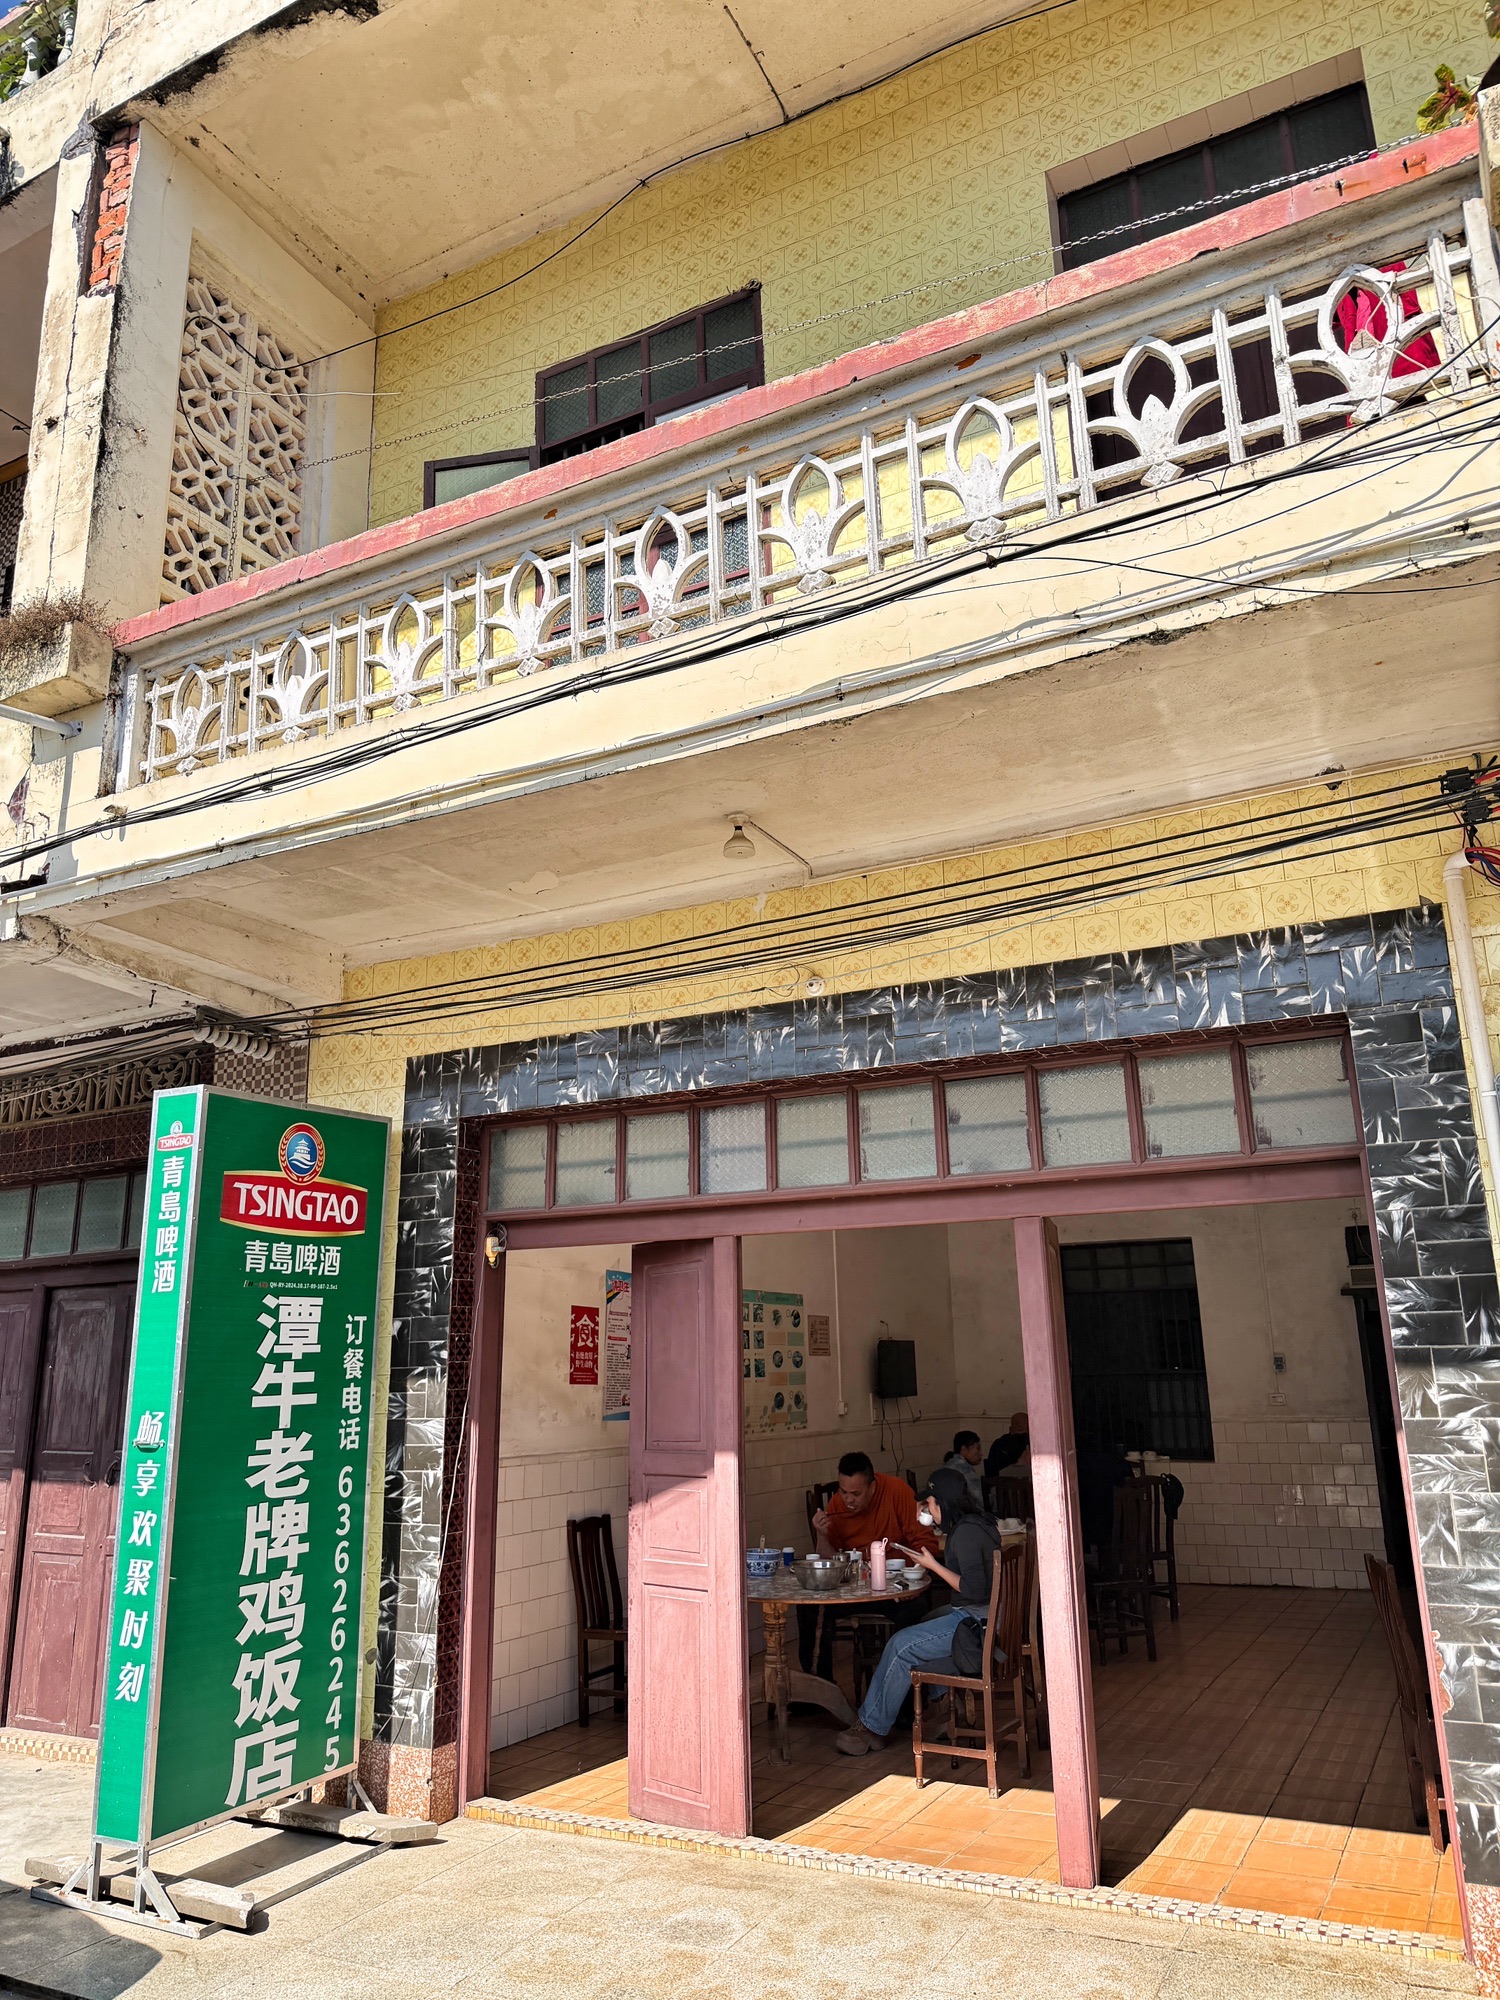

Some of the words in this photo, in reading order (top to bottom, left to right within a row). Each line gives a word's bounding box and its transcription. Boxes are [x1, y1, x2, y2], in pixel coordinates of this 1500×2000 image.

[160, 1136, 192, 1149] TSINGTAO
[233, 1182, 359, 1225] TSINGTAO
[151, 1156, 185, 1294] 青岛啤酒
[244, 1240, 342, 1276] 青岛啤酒
[338, 1314, 367, 1450] 订餐电话
[115, 1410, 165, 1702] 畅享欢聚时刻
[224, 1293, 324, 1807] 潭牛老牌鸡饭店
[323, 1466, 353, 1772] 63626245
